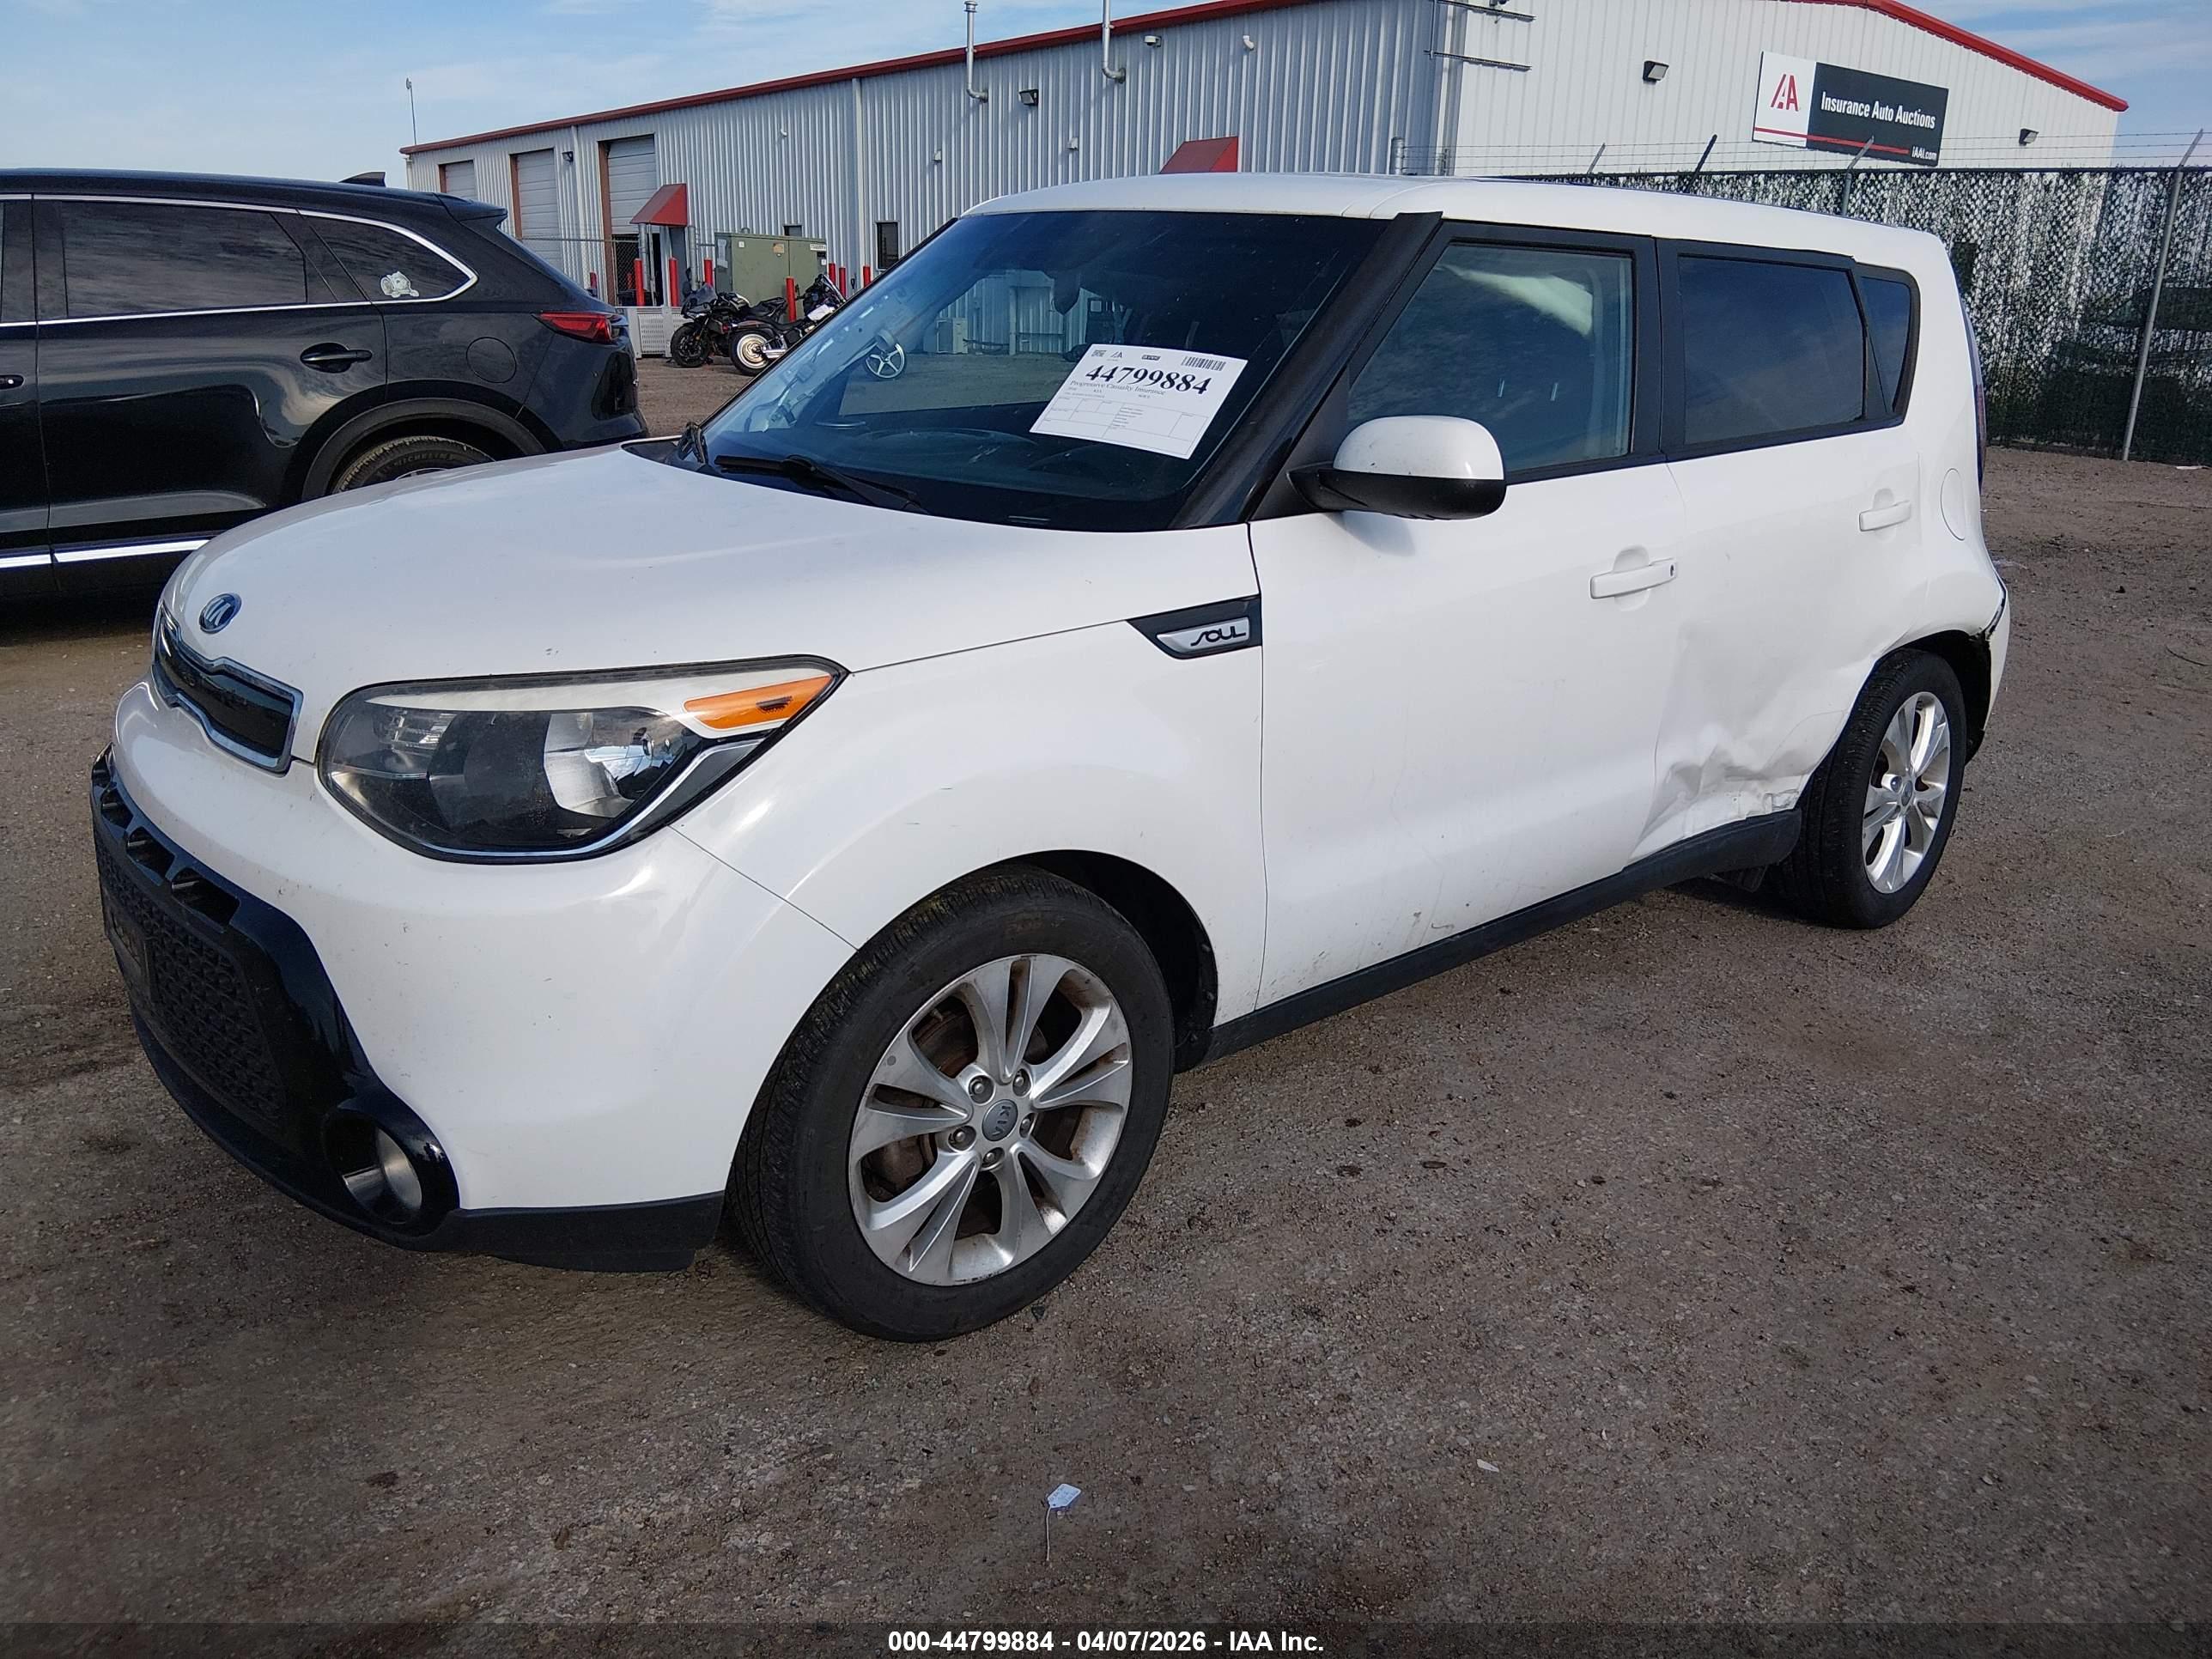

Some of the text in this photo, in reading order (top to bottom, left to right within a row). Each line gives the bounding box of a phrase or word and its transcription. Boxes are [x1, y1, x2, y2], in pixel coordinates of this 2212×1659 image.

[1821, 92, 1936, 129] Insurance Auto Auctions
[1085, 365, 1212, 395] 44799884
[1106, 383, 1133, 392] Casualty
[992, 1105, 1012, 1136] KIA
